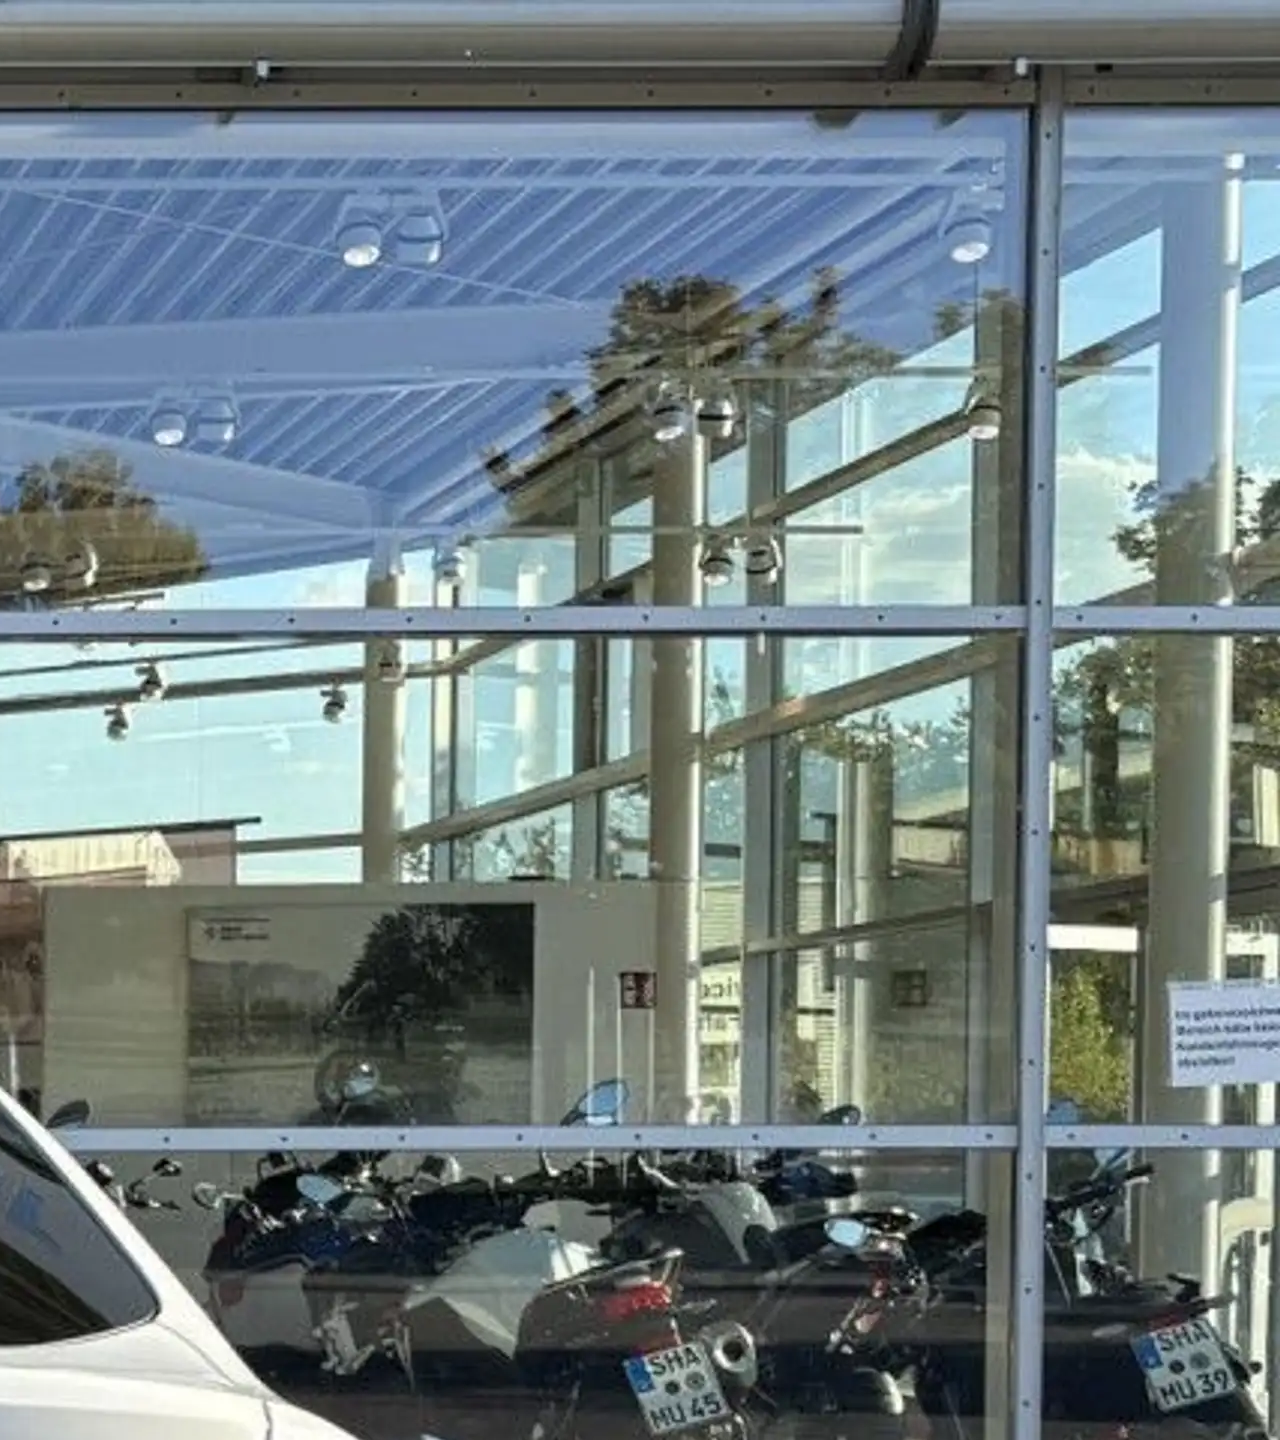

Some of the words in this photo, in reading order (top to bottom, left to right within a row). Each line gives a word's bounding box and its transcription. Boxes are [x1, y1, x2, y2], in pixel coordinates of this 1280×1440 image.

[1158, 1322, 1209, 1351] SHA
[648, 1347, 701, 1376] SHA
[1160, 1378, 1197, 1405] MU
[1196, 1368, 1228, 1394] 39
[650, 1403, 687, 1429] MU
[691, 1392, 721, 1417] 45
